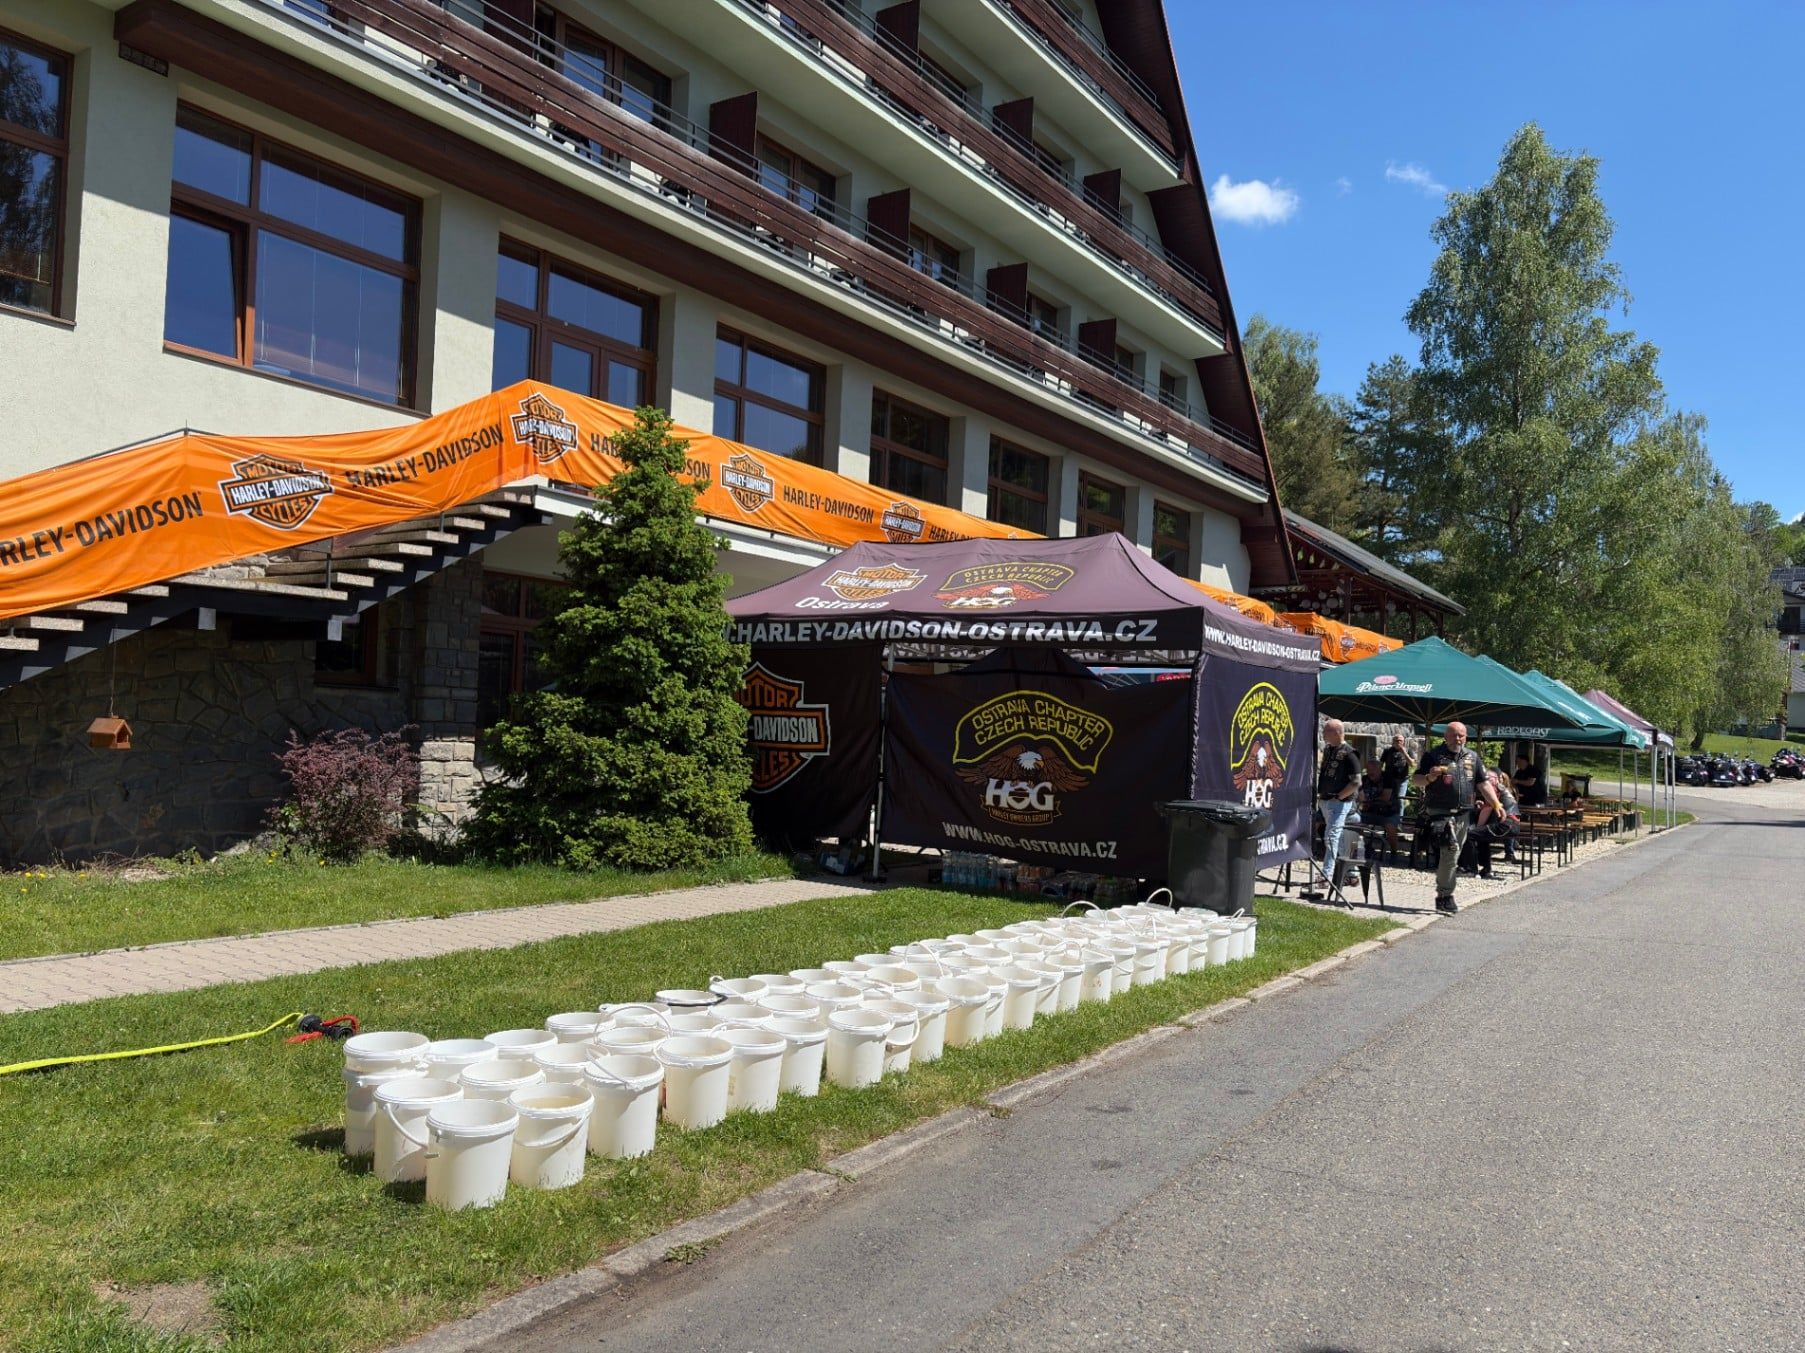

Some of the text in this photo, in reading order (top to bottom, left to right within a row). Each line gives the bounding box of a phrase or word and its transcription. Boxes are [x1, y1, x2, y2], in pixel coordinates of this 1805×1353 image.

[260, 497, 308, 523] CYCLES
[783, 485, 874, 523] HARLEY-DAVIDSON
[964, 566, 1018, 578] OSTRAVA
[795, 597, 889, 609] Ostrava
[1204, 624, 1320, 661] WWW.HARLEY-DAVIDSON-OSTRAVA.CZ
[1356, 681, 1433, 693] Pilsner Urquell
[972, 698, 1105, 738] OSTRAVA CHAPTER
[1238, 691, 1264, 728] OSTRAVA
[747, 716, 819, 743] -DAVIDSON
[974, 715, 1094, 751] CZECH REPUBLIC
[1497, 726, 1552, 738] RADEGAST
[985, 777, 1055, 811] HOG
[1245, 778, 1273, 809] HOG
[942, 821, 1117, 859] WWW.HOG-OSTRAVA.CZ
